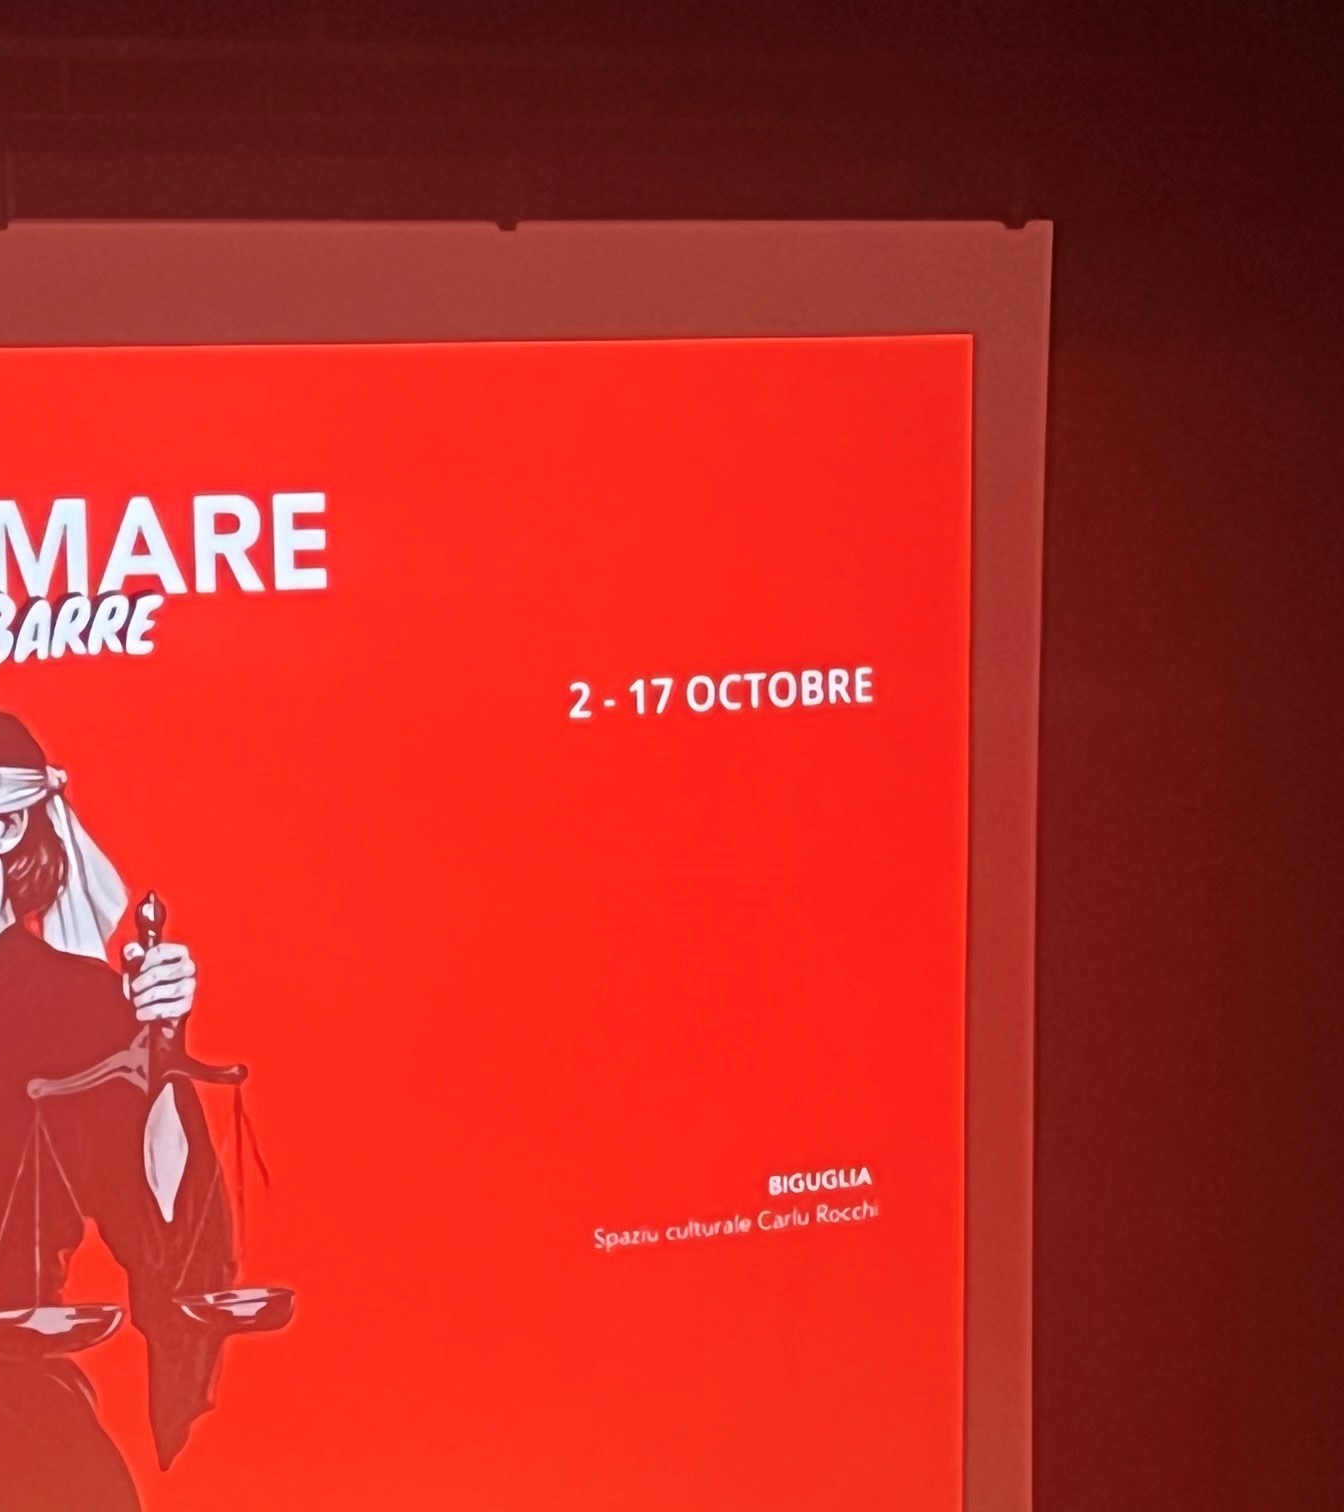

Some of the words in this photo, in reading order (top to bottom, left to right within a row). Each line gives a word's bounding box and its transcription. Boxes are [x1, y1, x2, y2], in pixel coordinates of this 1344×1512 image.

[569, 681, 592, 719] 2
[629, 677, 674, 714] 17
[686, 667, 874, 713] OCTOBRE
[768, 1167, 872, 1196] BIGUGLIA
[593, 1227, 659, 1252] Spaziu
[665, 1215, 752, 1241] culturale
[757, 1206, 810, 1231] Carlu
[816, 1199, 880, 1225] Rocchi
